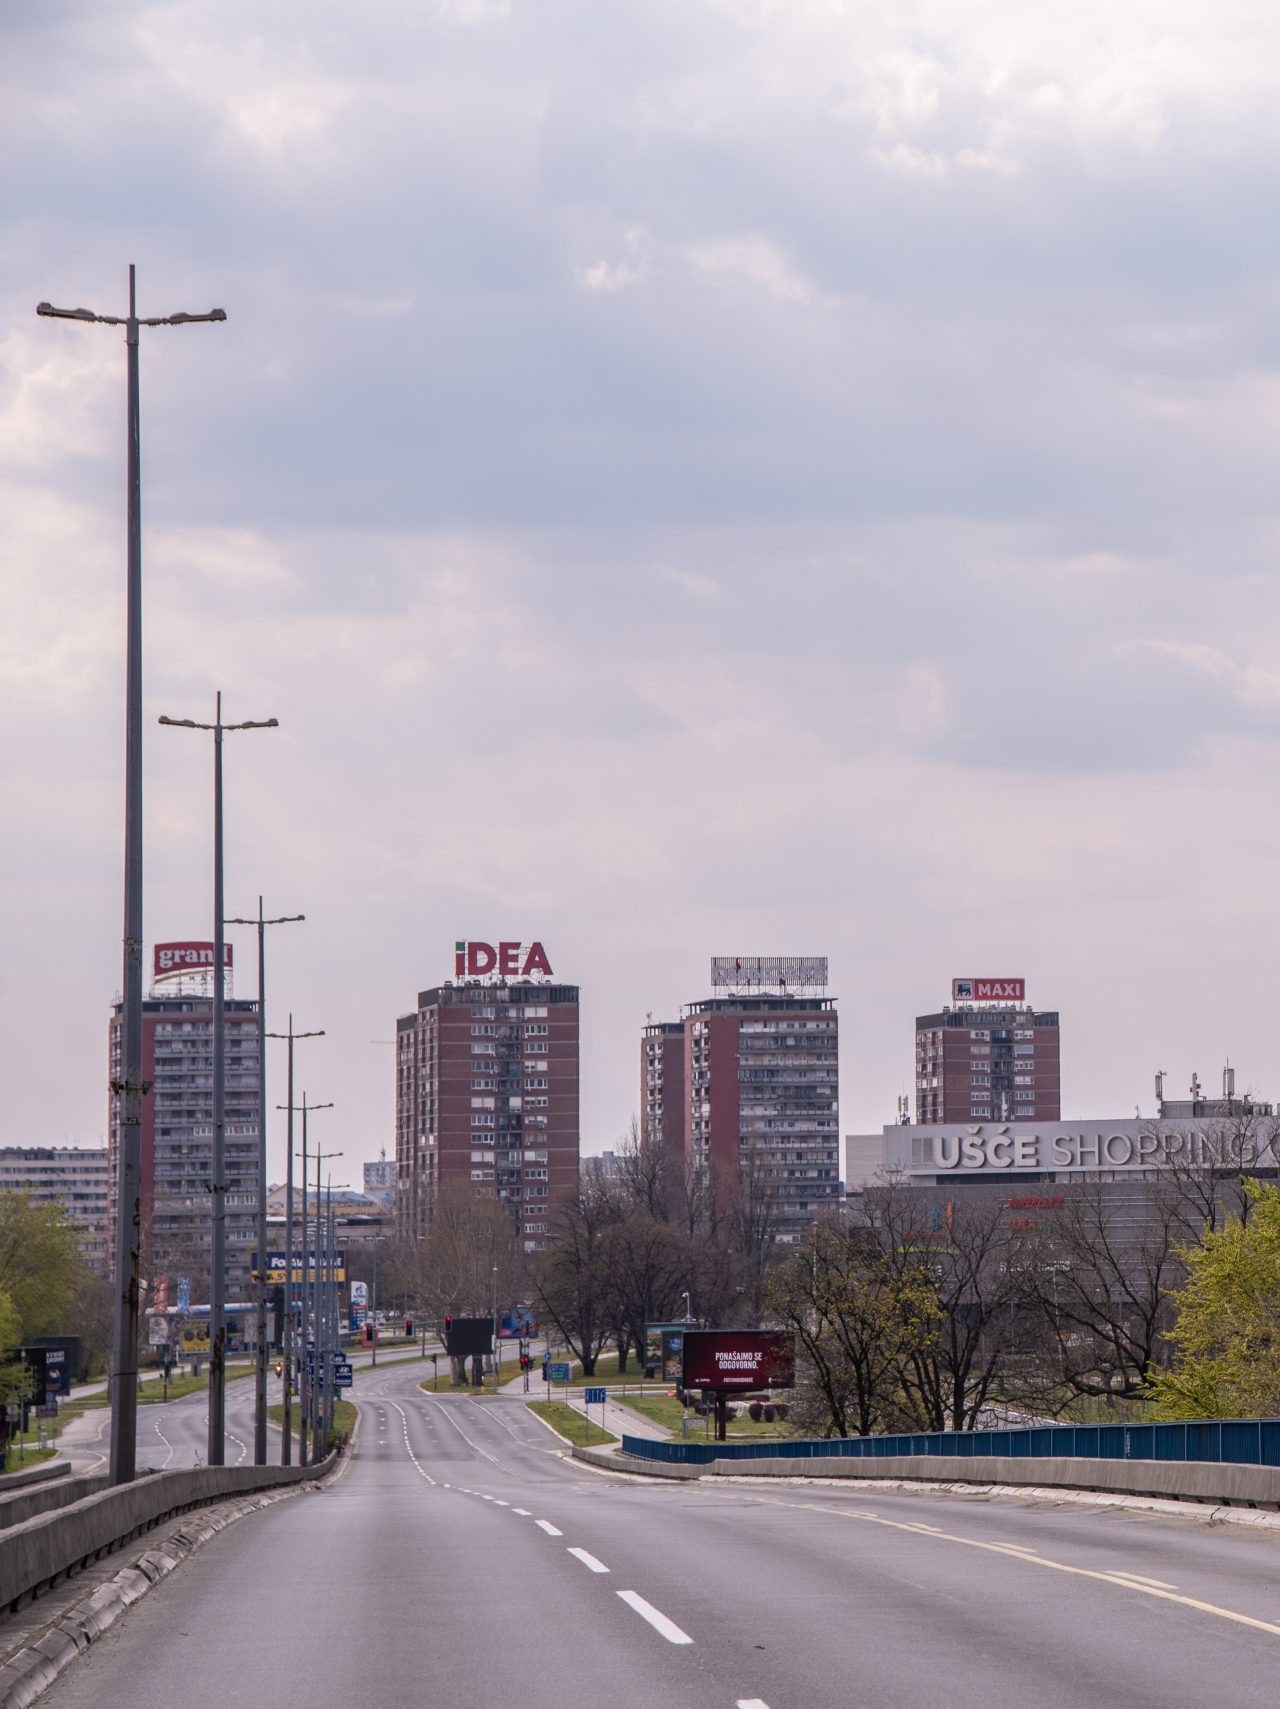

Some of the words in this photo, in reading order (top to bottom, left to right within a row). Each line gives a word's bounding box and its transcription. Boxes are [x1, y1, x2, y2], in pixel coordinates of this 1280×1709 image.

[978, 983, 1021, 996] MAXI
[934, 1125, 1039, 1169] UŠĆE
[1052, 1131, 1257, 1166] SHOPPING
[715, 1351, 753, 1361] PONAŠAJMO
[754, 1352, 762, 1361] SE
